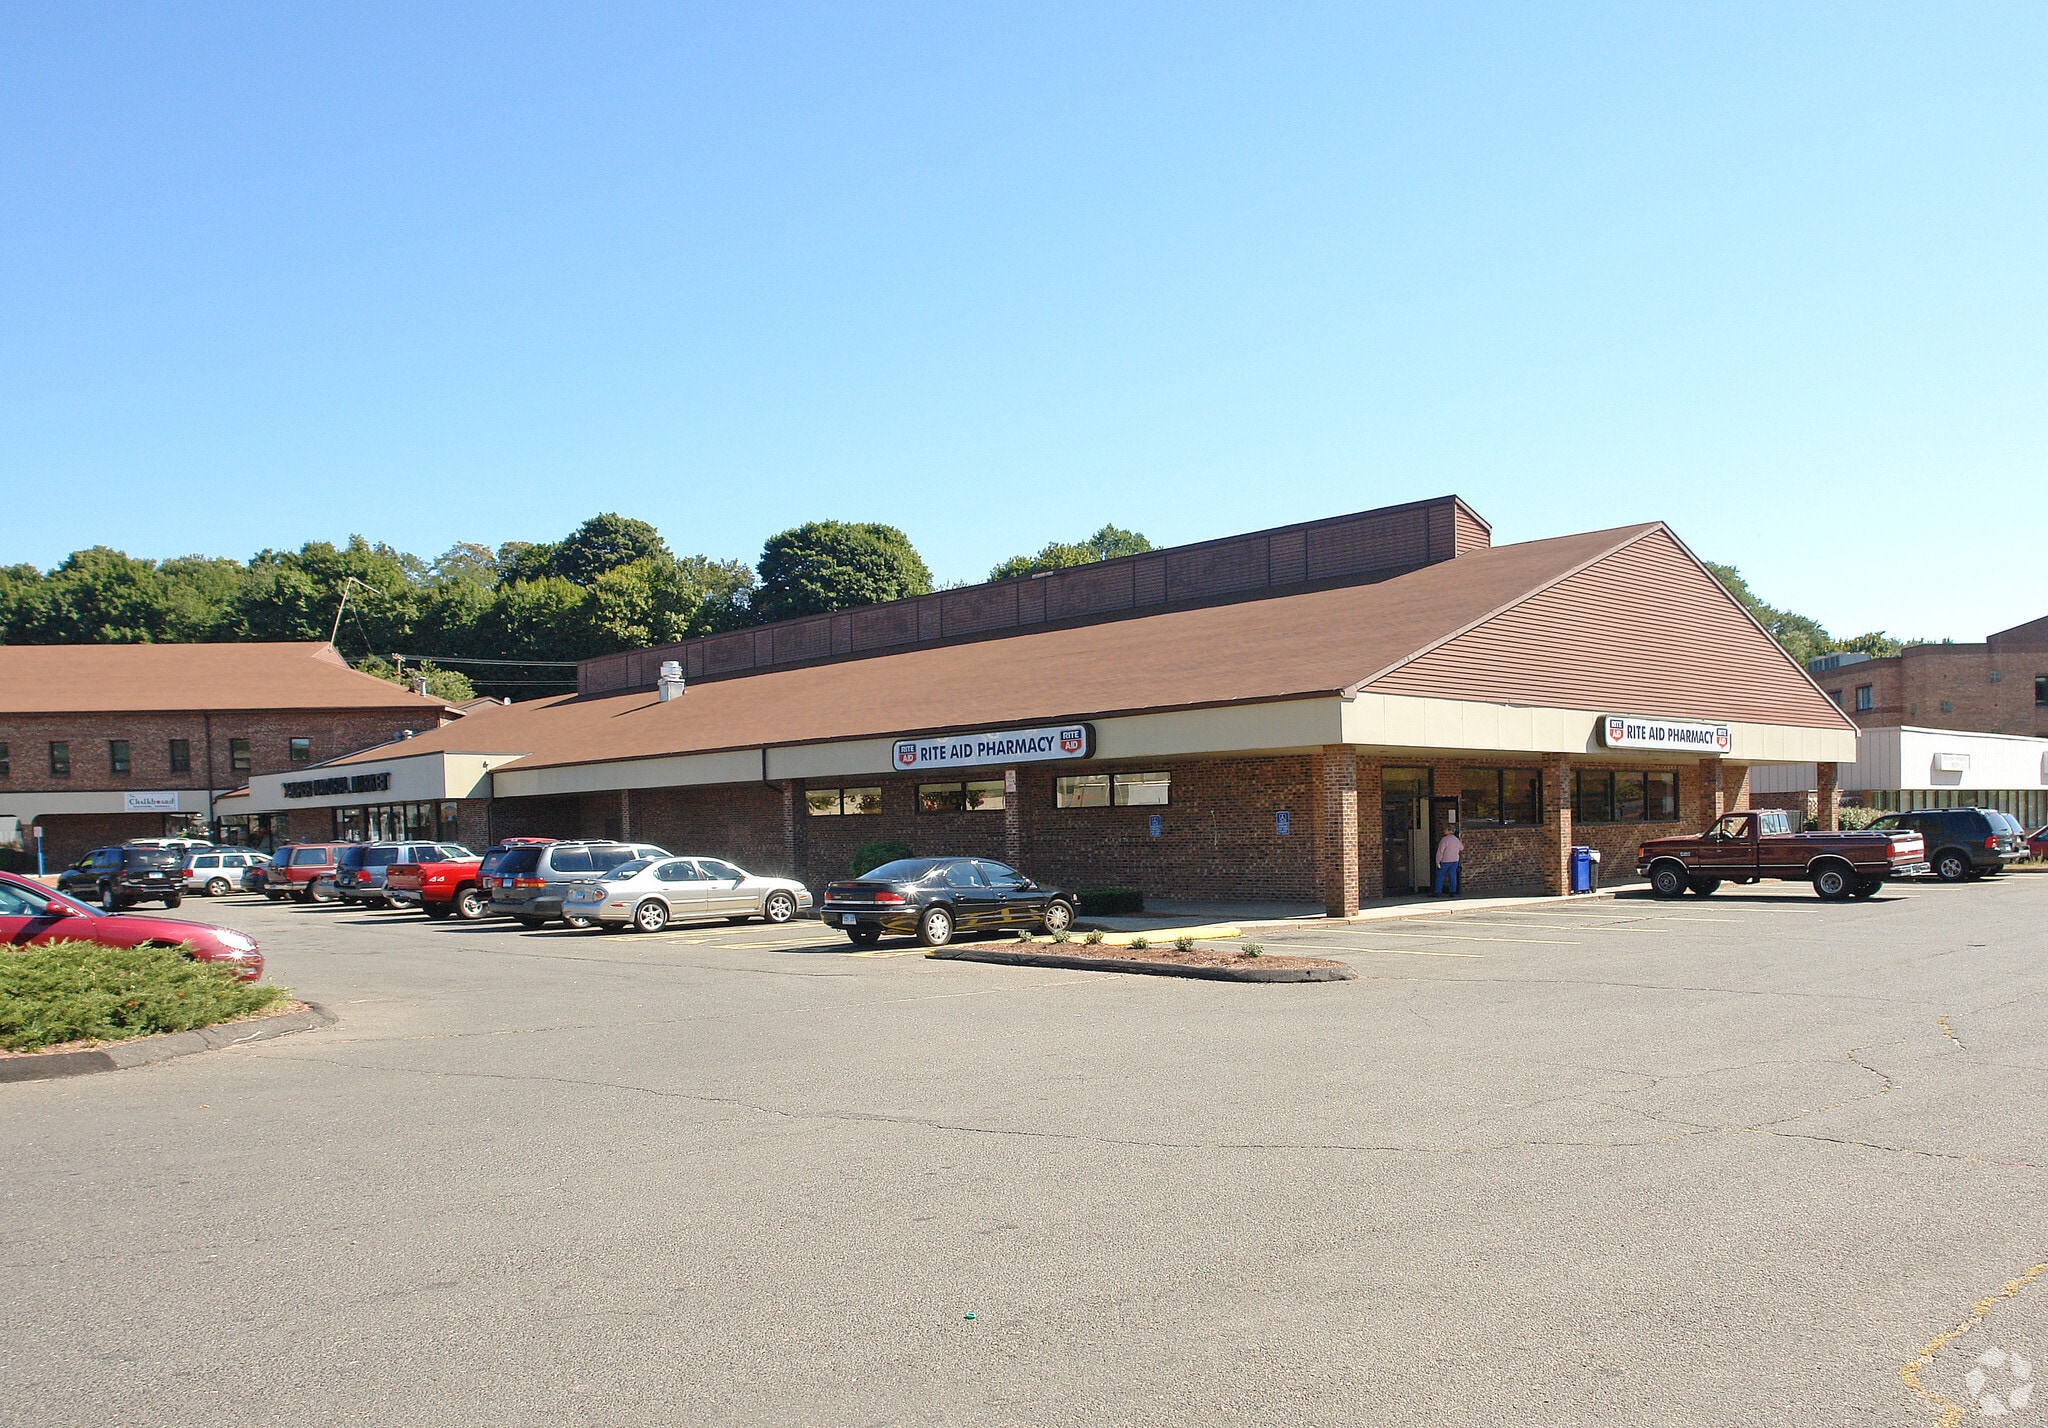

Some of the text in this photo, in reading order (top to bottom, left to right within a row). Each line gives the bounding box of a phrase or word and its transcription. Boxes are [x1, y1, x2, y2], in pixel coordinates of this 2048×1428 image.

[1611, 720, 1623, 728] RITE
[1062, 730, 1080, 739] RITE
[1612, 729, 1622, 738] AID
[1627, 724, 1714, 744] RITE AID PHARMACY
[900, 744, 915, 753] RITE
[920, 736, 1055, 761] RITE AID PHARMACY
[1064, 741, 1078, 750] AID
[902, 754, 914, 762] AID
[351, 772, 391, 793] MARKET
[129, 797, 174, 805] Chalkboard
